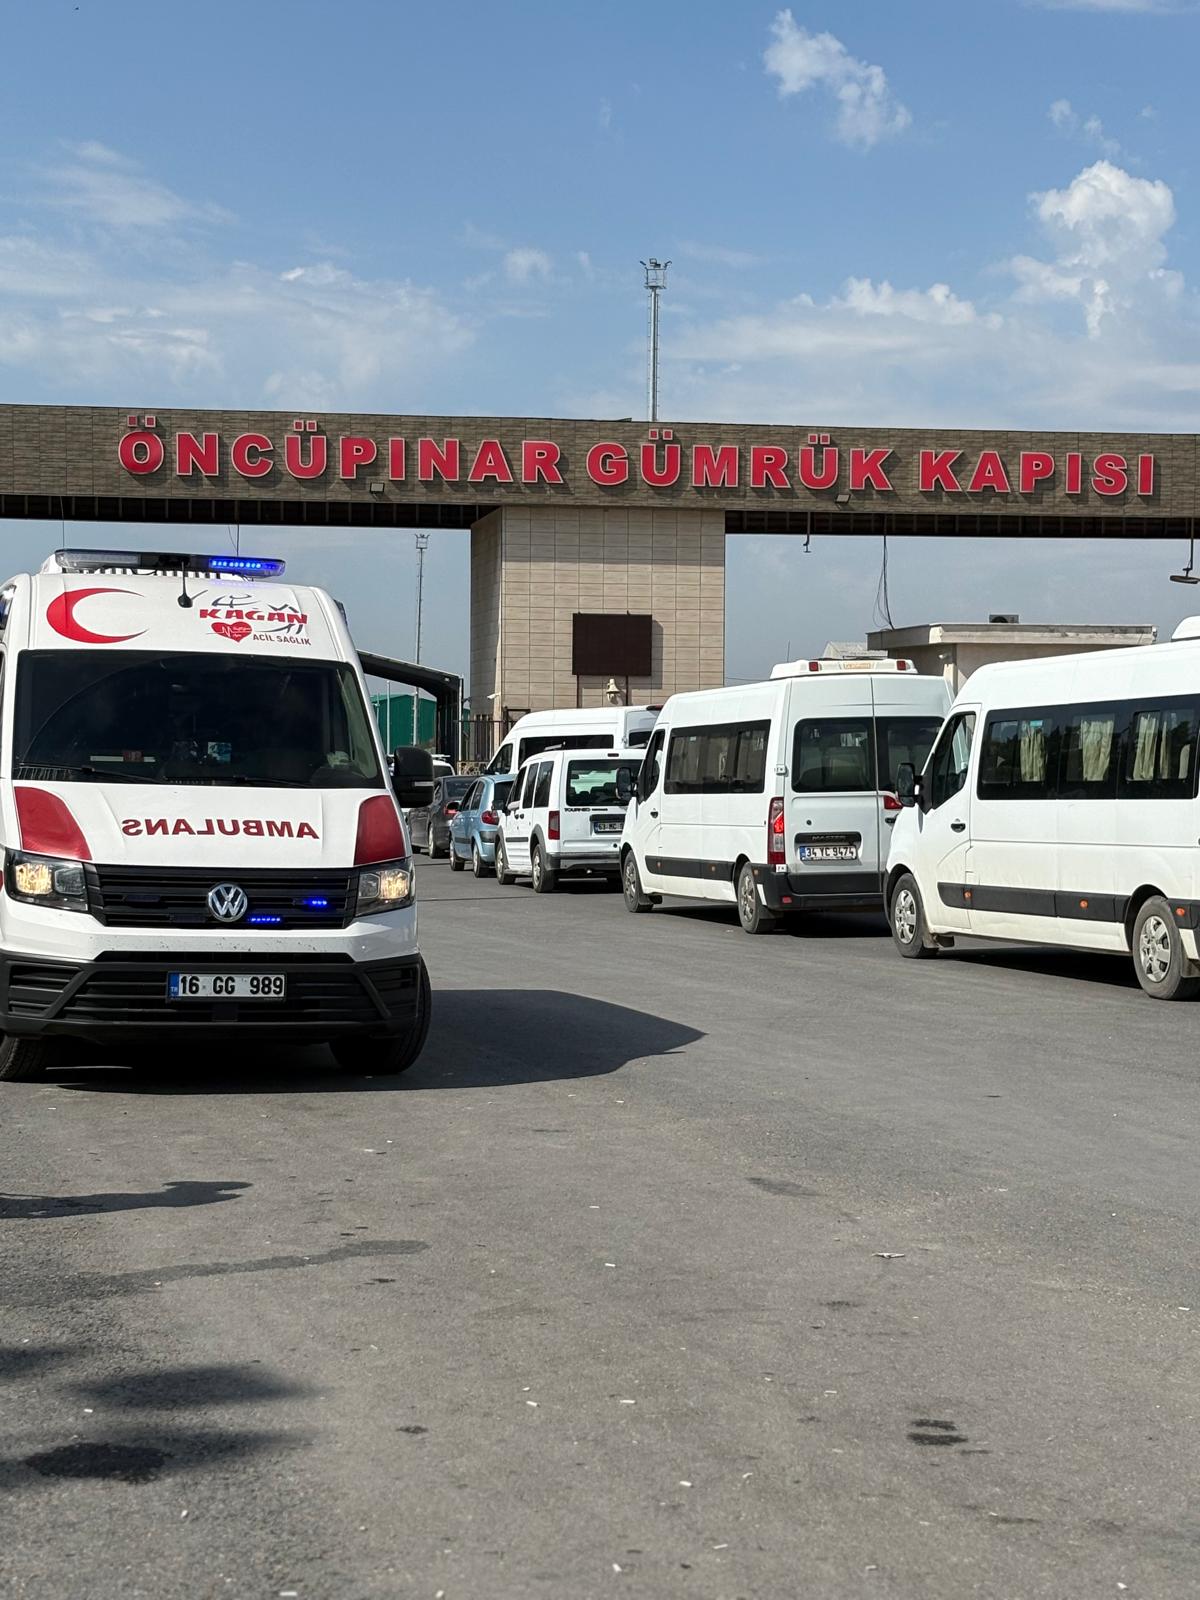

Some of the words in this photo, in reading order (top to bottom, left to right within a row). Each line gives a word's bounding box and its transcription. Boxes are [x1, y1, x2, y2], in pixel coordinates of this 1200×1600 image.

[118, 414, 564, 484] ÖNCÜPINAR
[586, 428, 893, 491] GÜMRÜK
[919, 449, 1155, 496] KAPISI
[252, 633, 274, 642] ACİL
[276, 635, 311, 645] SAĞLIK
[806, 847, 817, 857] 34
[820, 847, 830, 856] YC
[833, 847, 854, 856] 9474
[181, 976, 200, 994] 16
[212, 976, 236, 994] GG
[249, 976, 283, 995] 989
